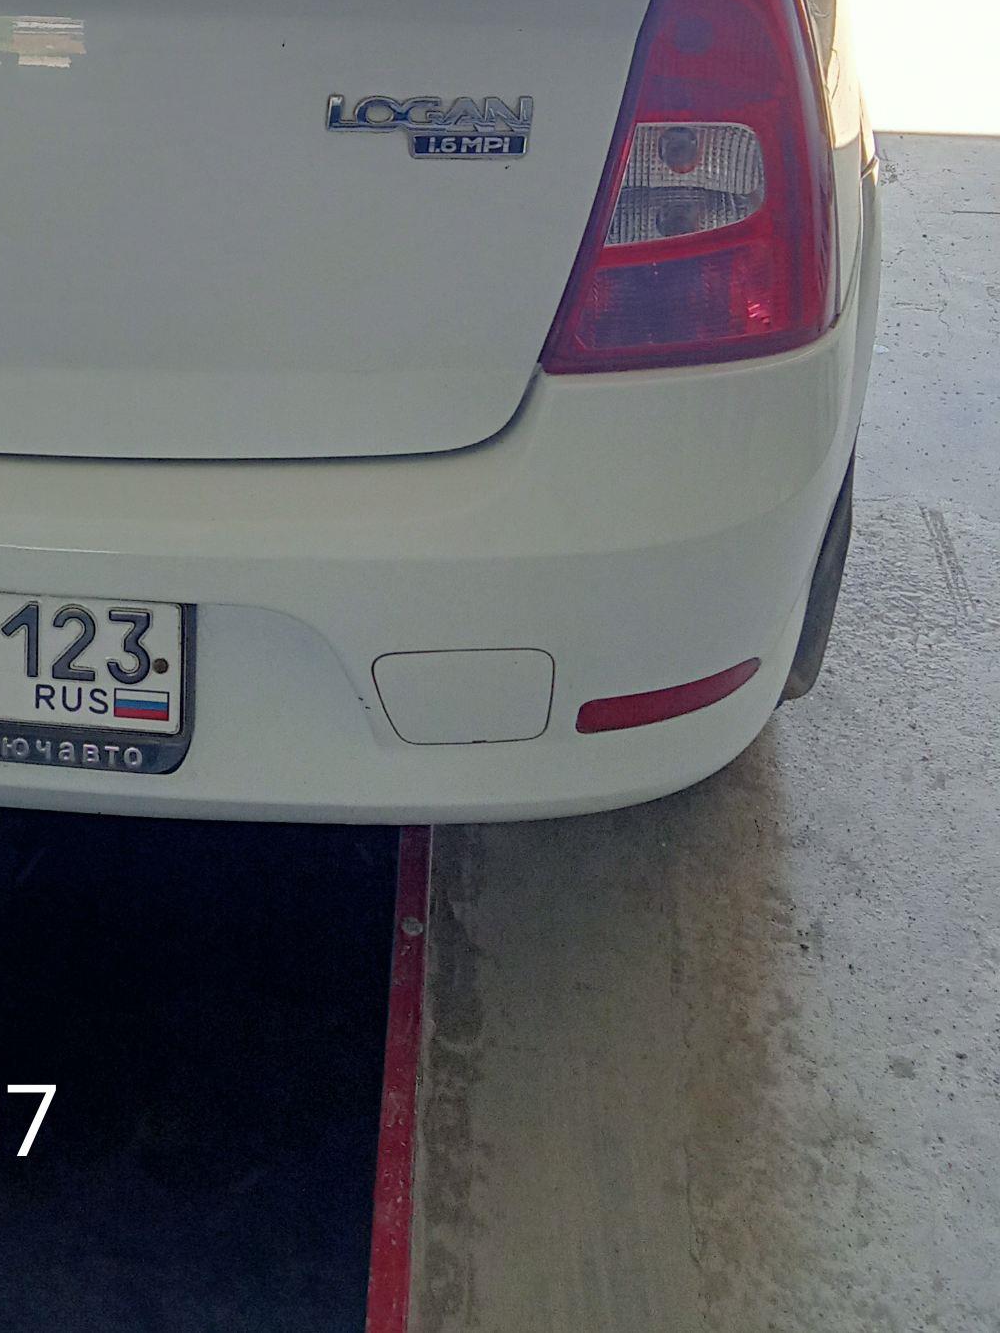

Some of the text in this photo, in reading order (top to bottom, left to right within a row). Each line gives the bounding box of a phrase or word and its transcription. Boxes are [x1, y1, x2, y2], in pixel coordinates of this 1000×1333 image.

[325, 93, 534, 133] LOGAN
[1, 602, 154, 685] 123
[35, 684, 109, 715] RUS
